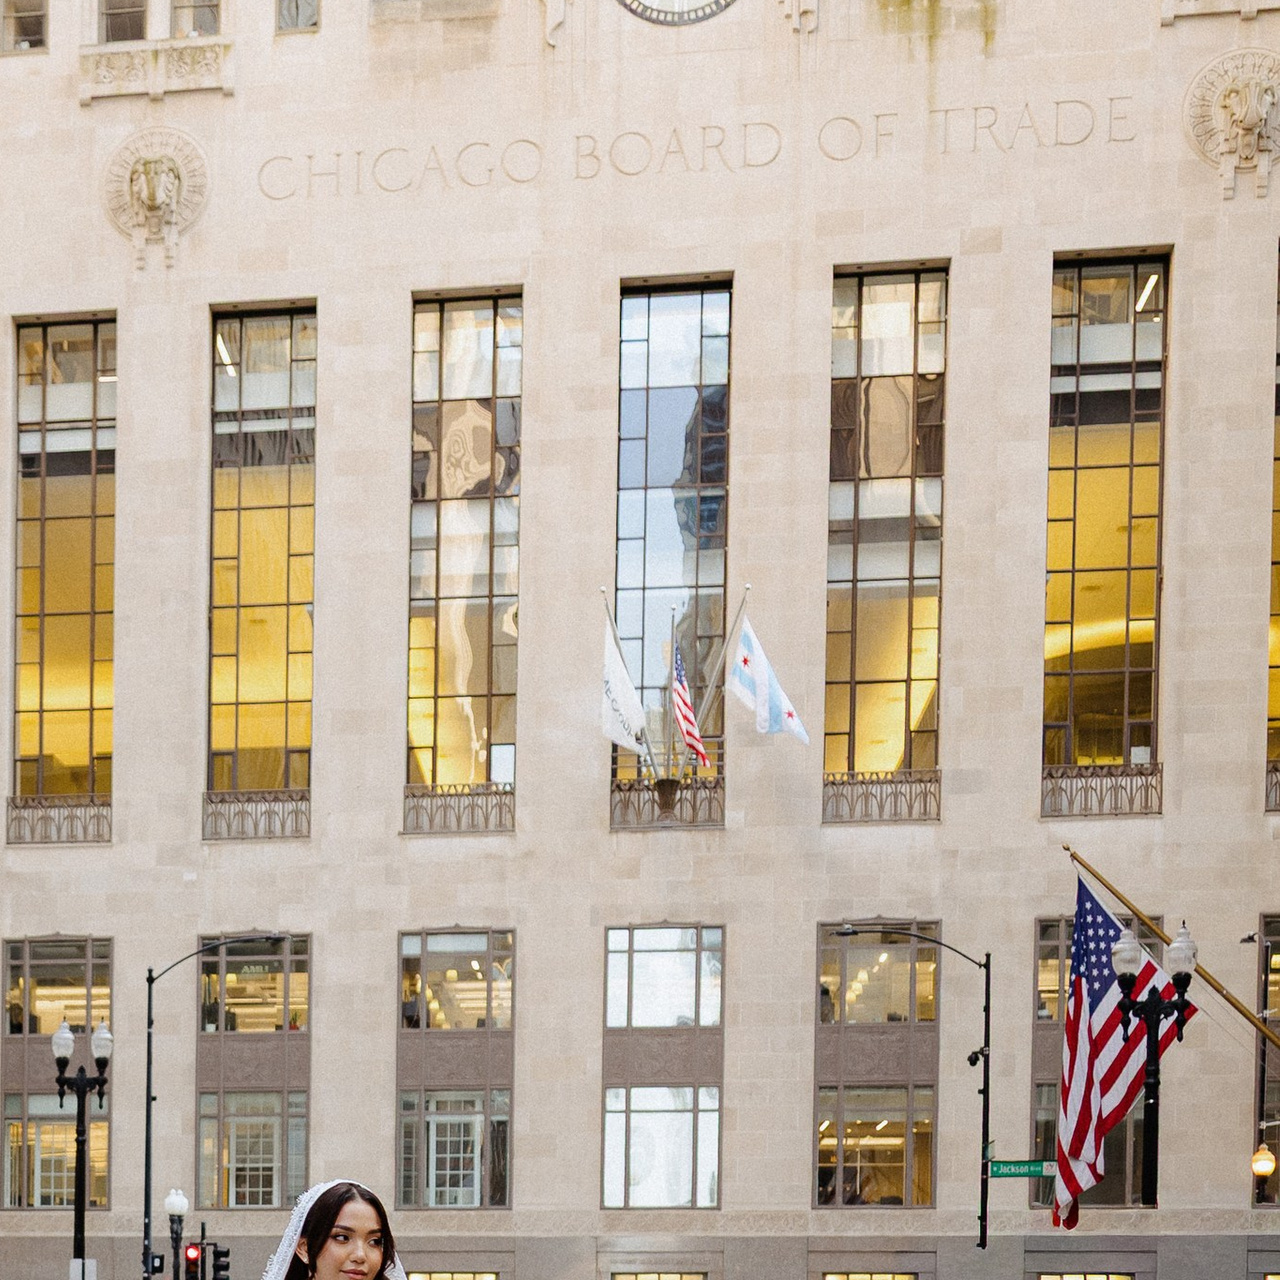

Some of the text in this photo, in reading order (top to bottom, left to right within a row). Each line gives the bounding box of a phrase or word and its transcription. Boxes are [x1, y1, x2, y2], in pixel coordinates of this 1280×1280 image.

[257, 96, 1138, 201] CHICAGO BOARD OF TRADE
[999, 1164, 1028, 1173] Jackson
